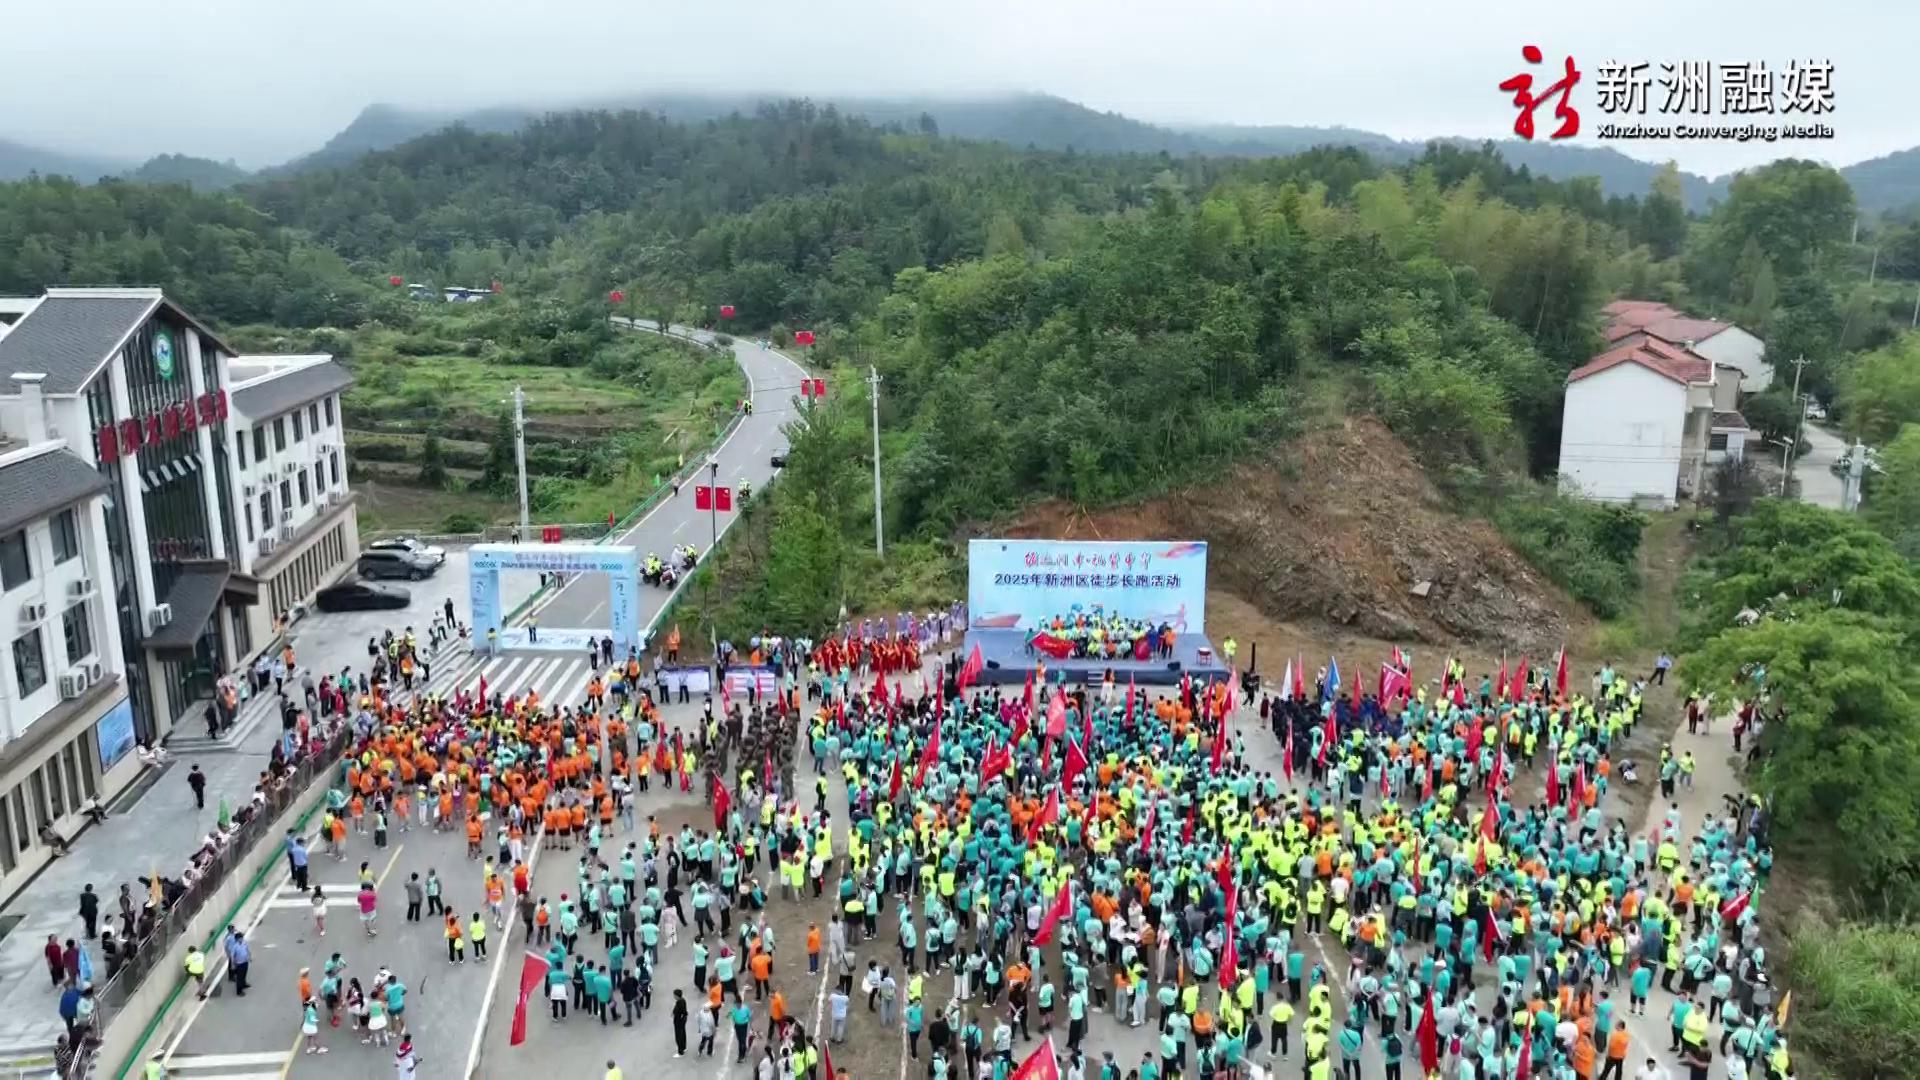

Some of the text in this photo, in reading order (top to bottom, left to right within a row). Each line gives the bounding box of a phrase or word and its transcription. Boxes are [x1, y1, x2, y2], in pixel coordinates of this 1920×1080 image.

[994, 573, 1181, 589] 2025年新洲区徒步长跑活动
